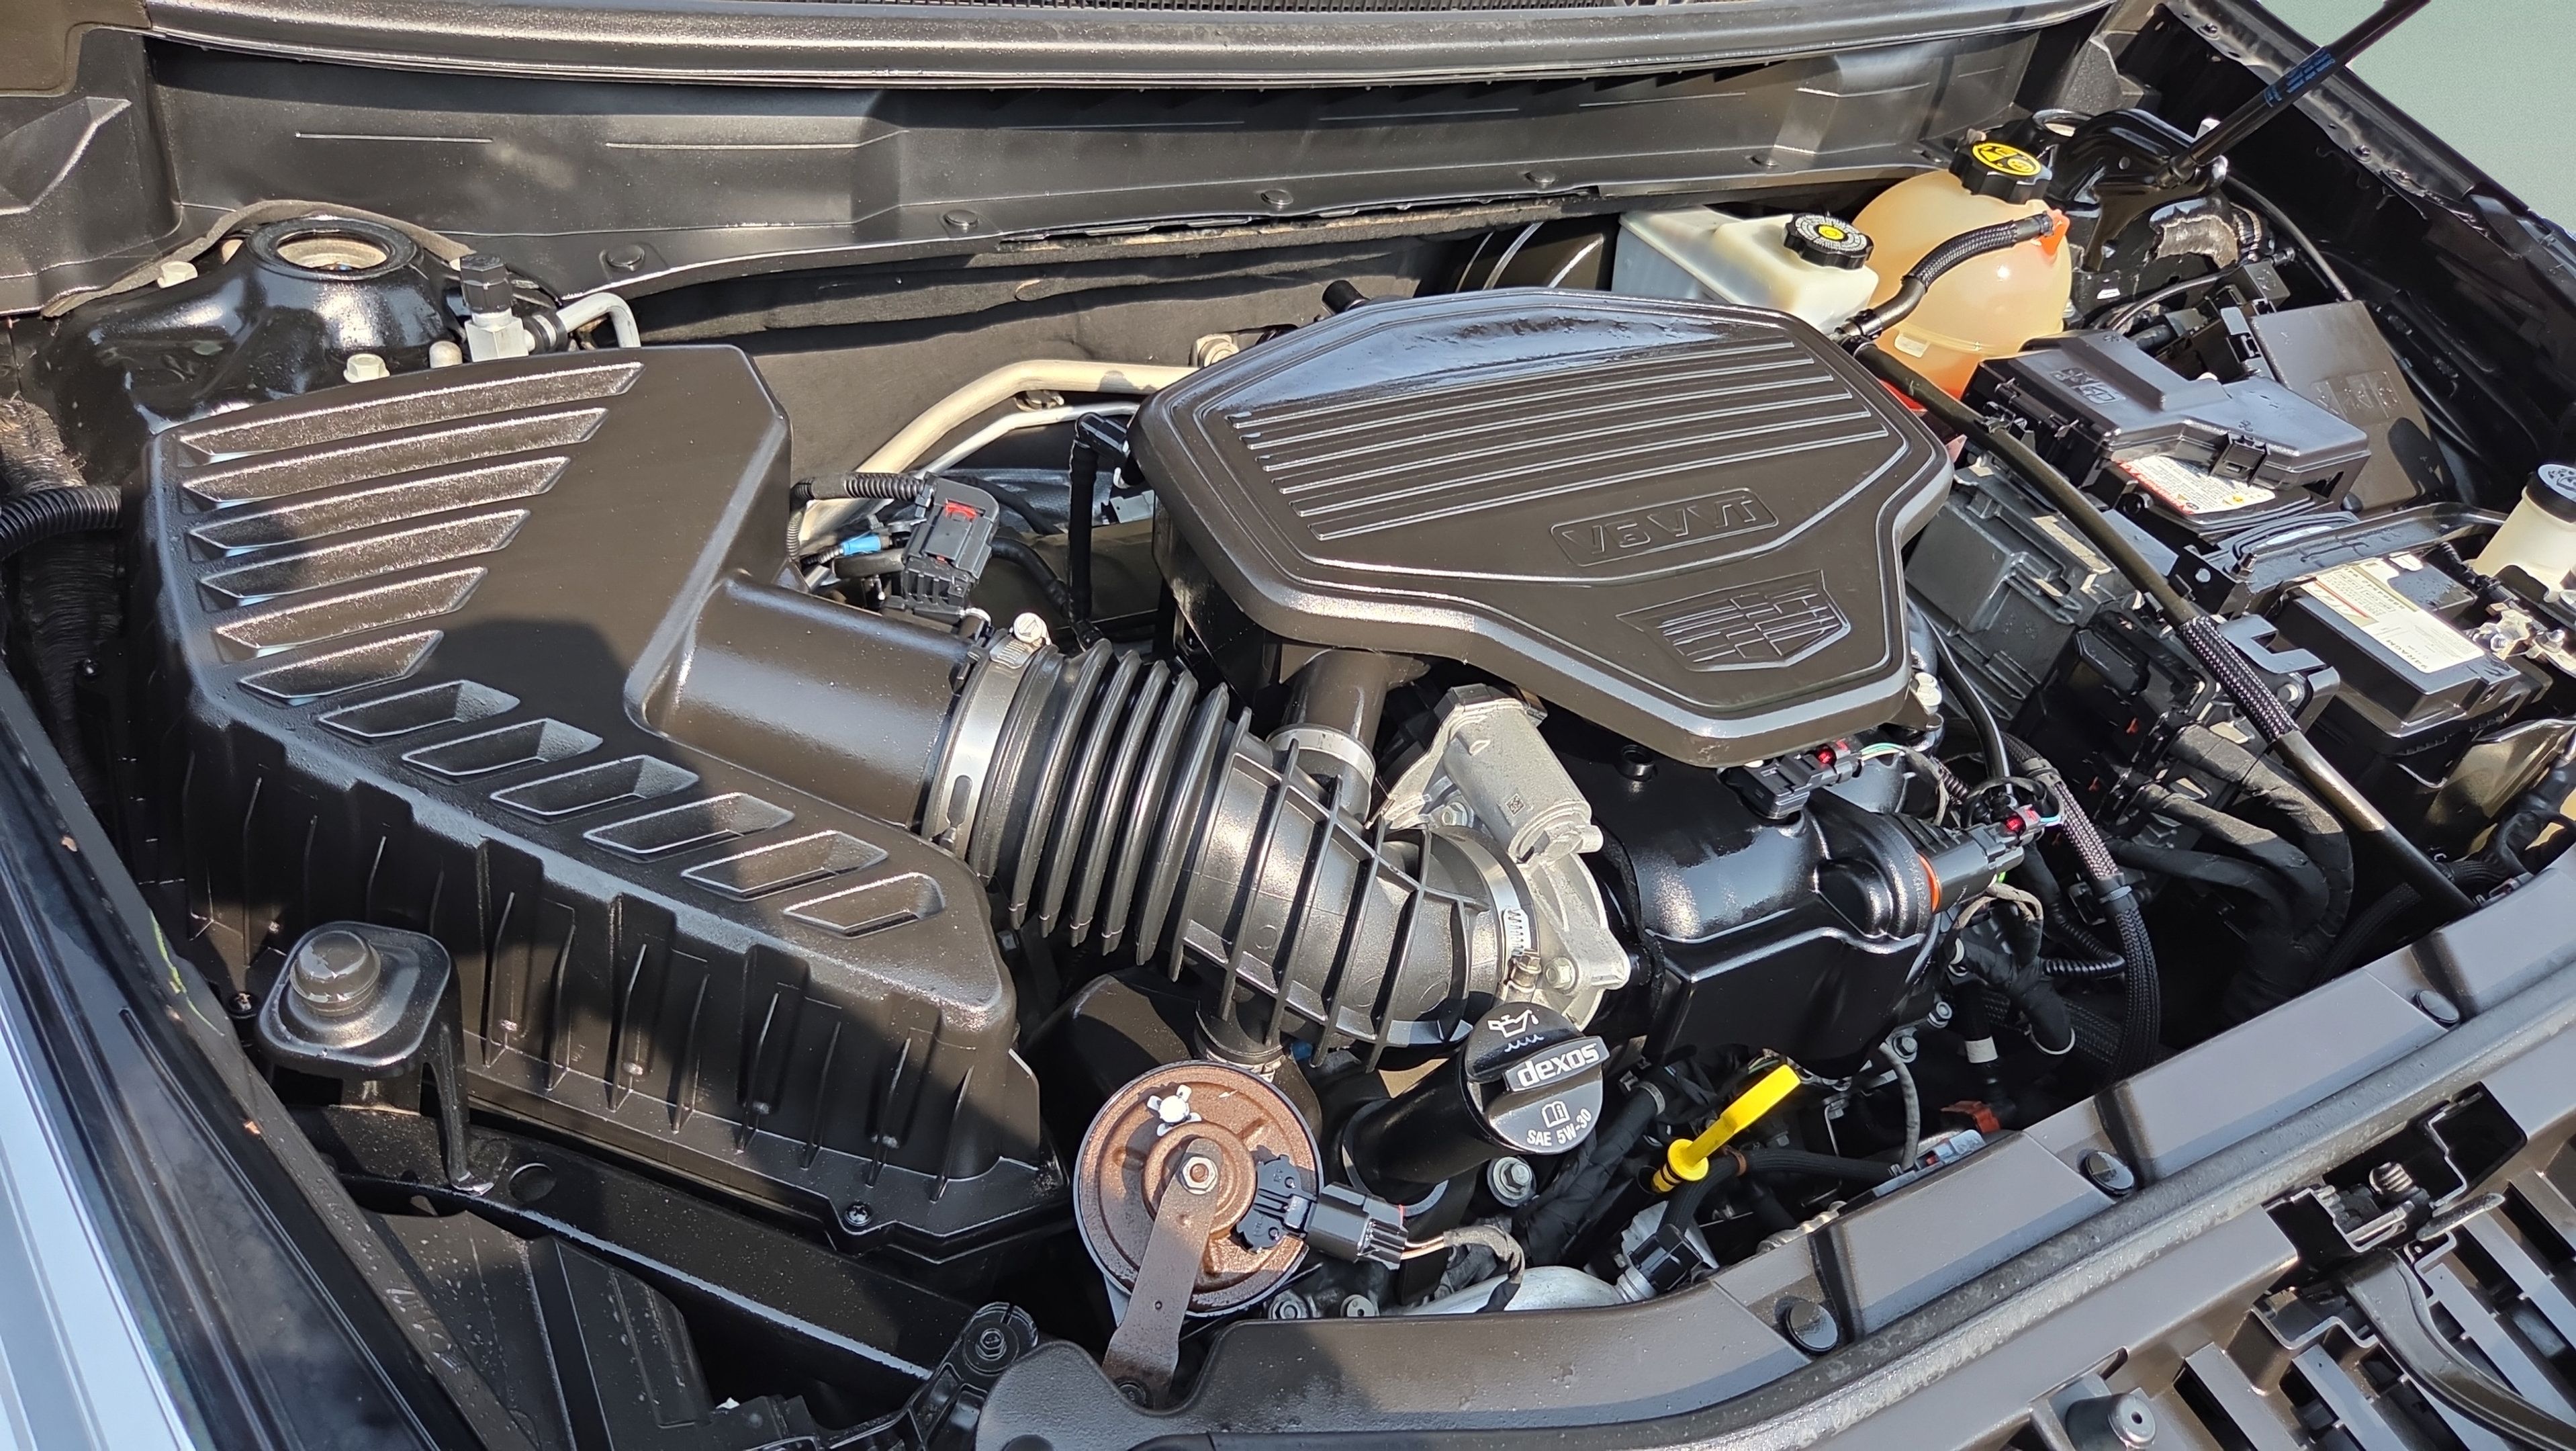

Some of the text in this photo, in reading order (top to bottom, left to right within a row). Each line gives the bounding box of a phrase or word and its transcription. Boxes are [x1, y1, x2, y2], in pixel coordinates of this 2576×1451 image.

[1563, 498, 1756, 556] V6 VVT
[1517, 1043, 1600, 1088] dexos
[1526, 1108, 1592, 1146] SAE 5W-30
